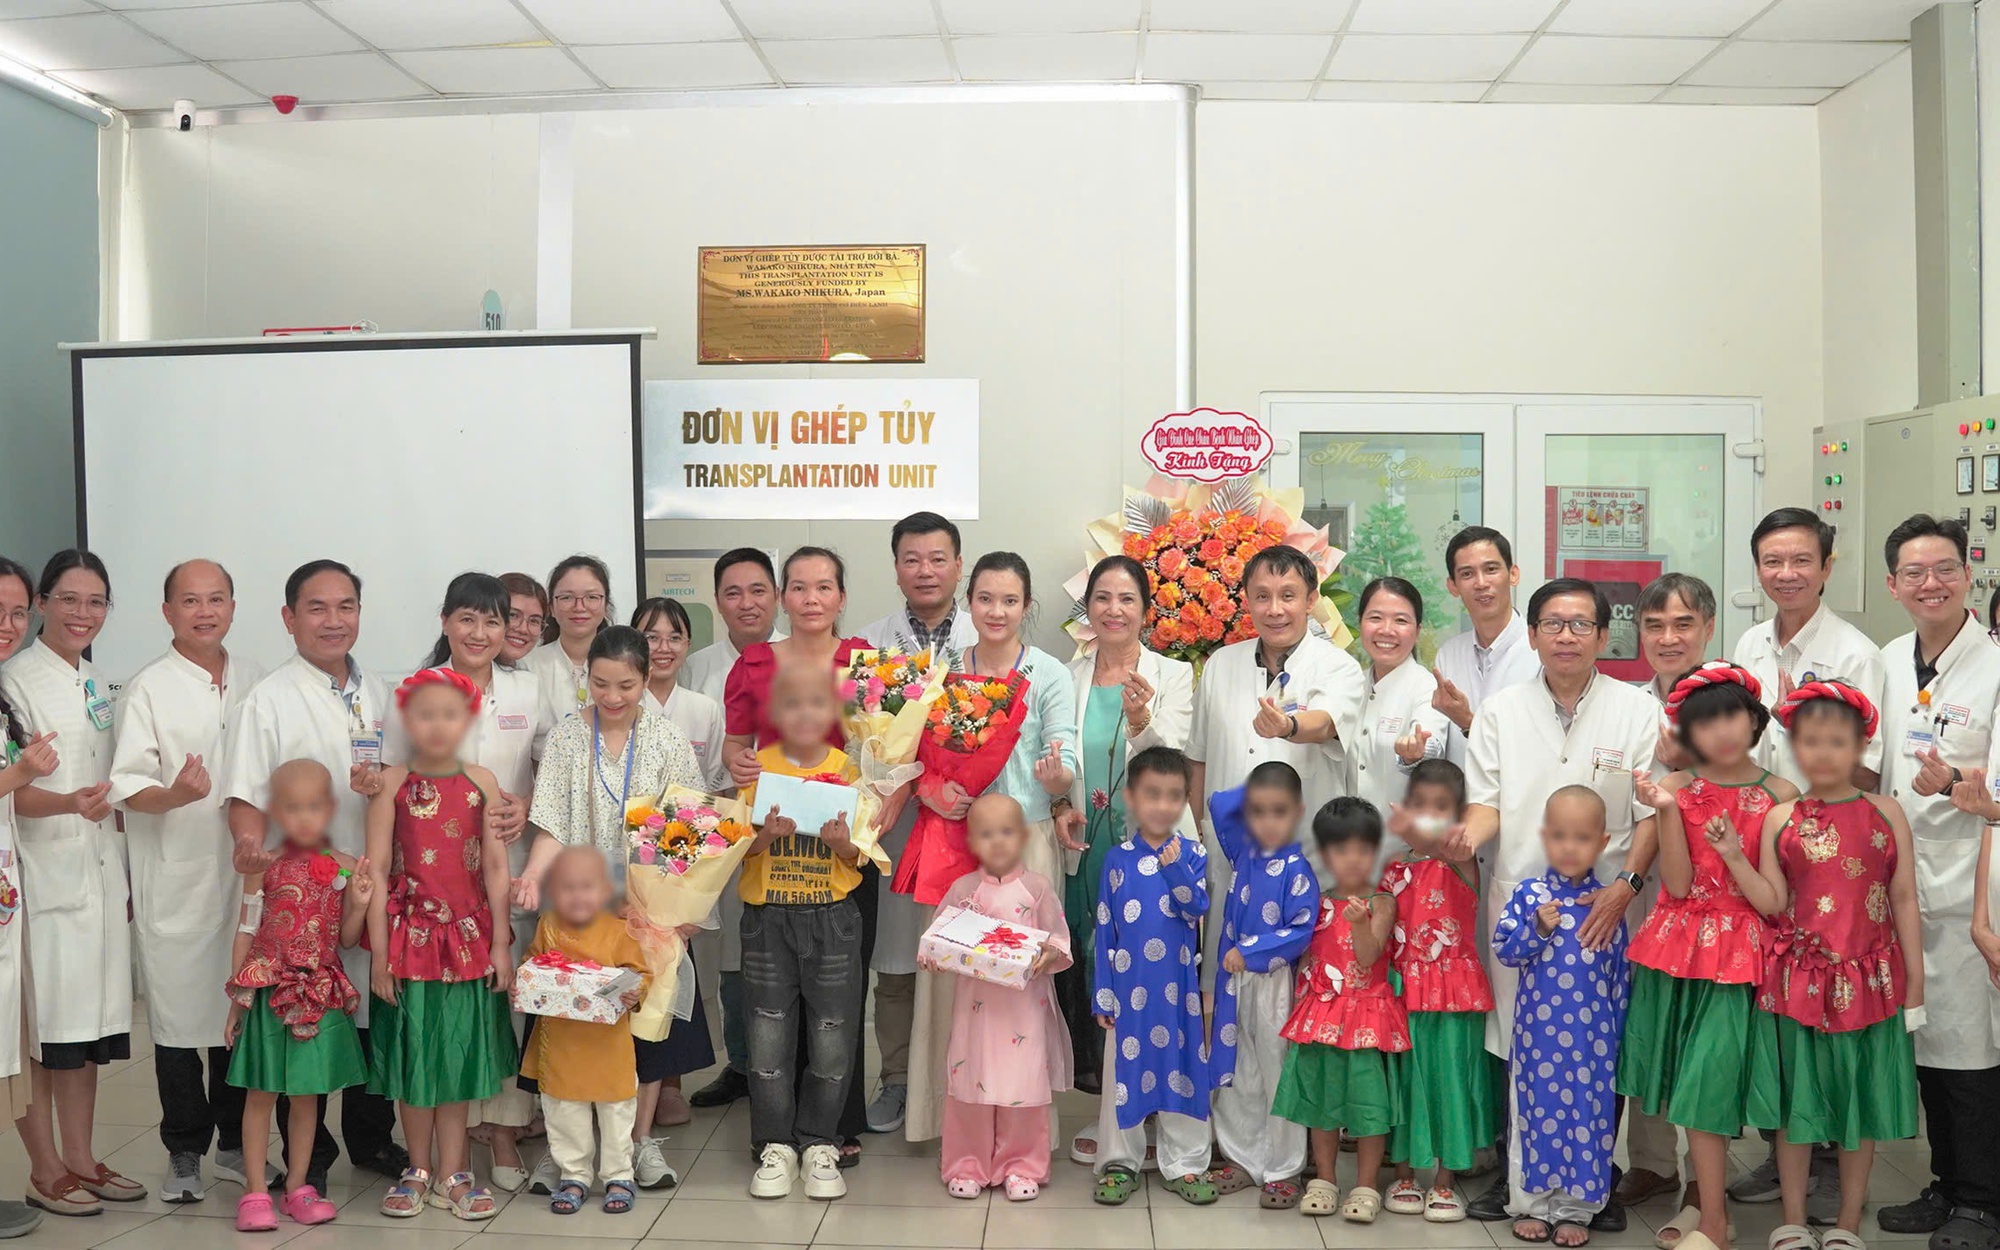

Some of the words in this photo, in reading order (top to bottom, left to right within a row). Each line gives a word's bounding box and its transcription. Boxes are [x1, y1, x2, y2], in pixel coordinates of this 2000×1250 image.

[756, 253, 780, 262] GHÉP
[847, 253, 865, 262] TRỢ
[867, 251, 883, 260] BỞI
[762, 271, 848, 279] TRANSPLANTATION
[816, 279, 853, 287] FUNDED
[854, 288, 886, 298] Japan
[485, 312, 501, 331] 510
[682, 407, 743, 445] ĐƠN
[752, 411, 779, 450] VỊ
[791, 404, 867, 445] GHÉP
[879, 399, 936, 445] TỦY
[1209, 452, 1252, 471] Tặng
[1308, 440, 1391, 470] Merry
[1389, 458, 1481, 481] Christmas
[683, 464, 879, 488] TRANSPLANTATION
[888, 464, 937, 488] UNIT
